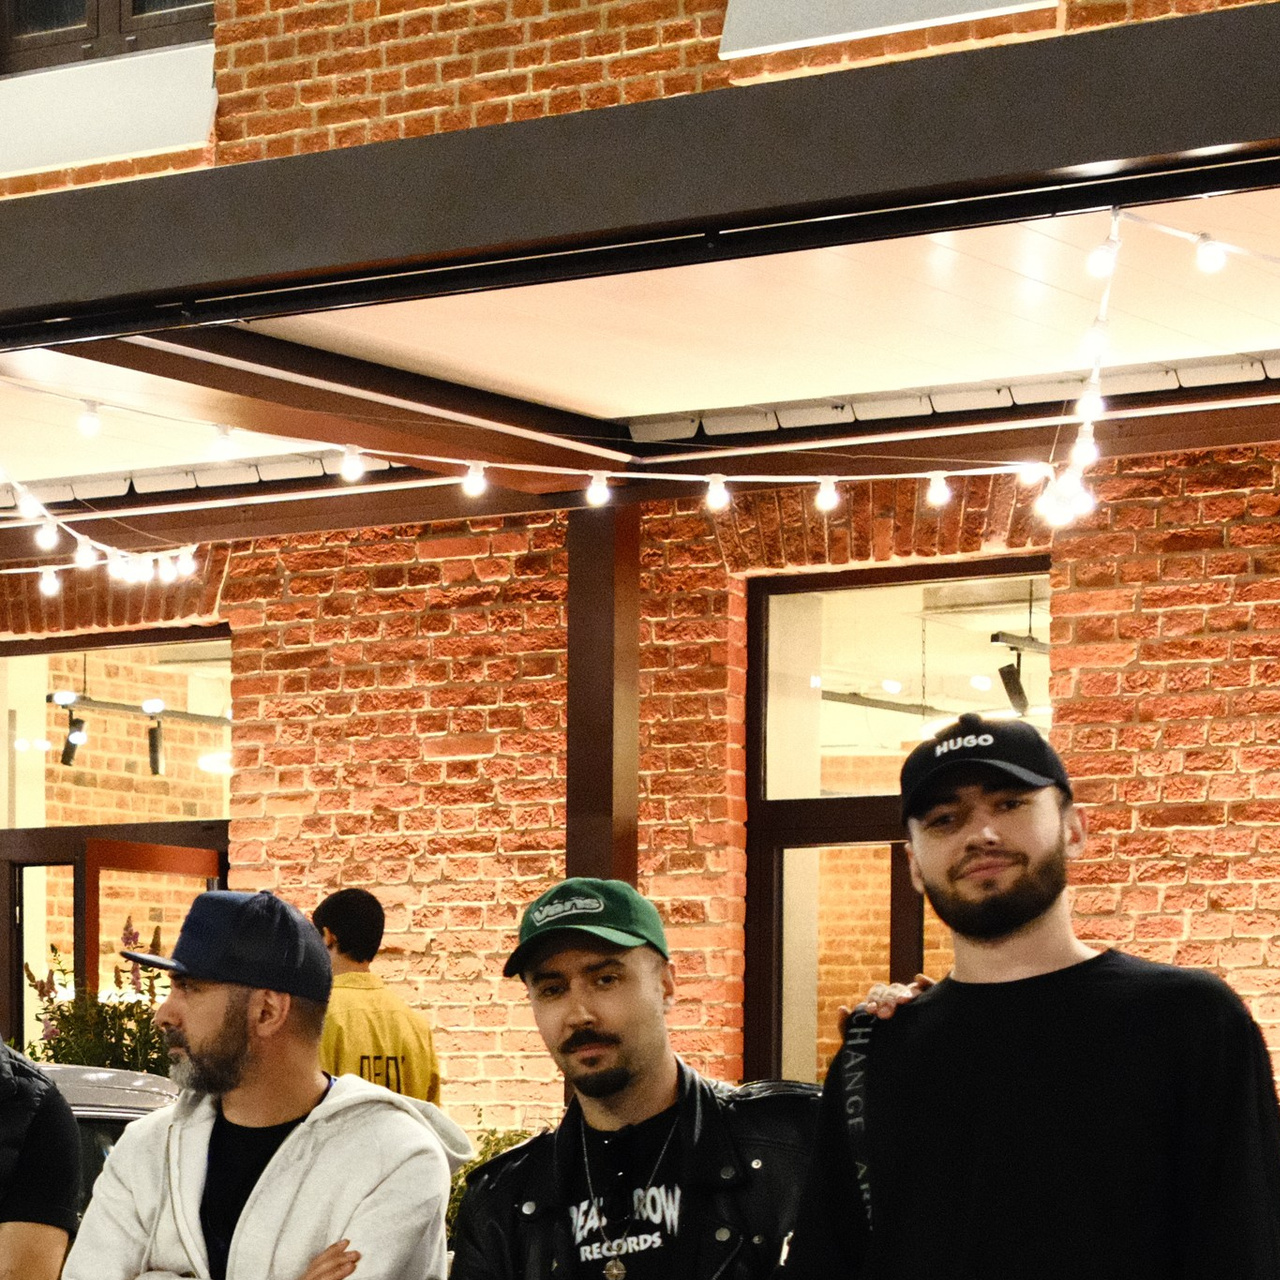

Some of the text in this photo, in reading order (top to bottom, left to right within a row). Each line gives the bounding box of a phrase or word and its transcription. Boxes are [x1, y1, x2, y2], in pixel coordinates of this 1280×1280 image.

[935, 733, 994, 758] HUGO
[633, 1184, 682, 1237] ROW
[580, 1231, 662, 1262] RECORDS
